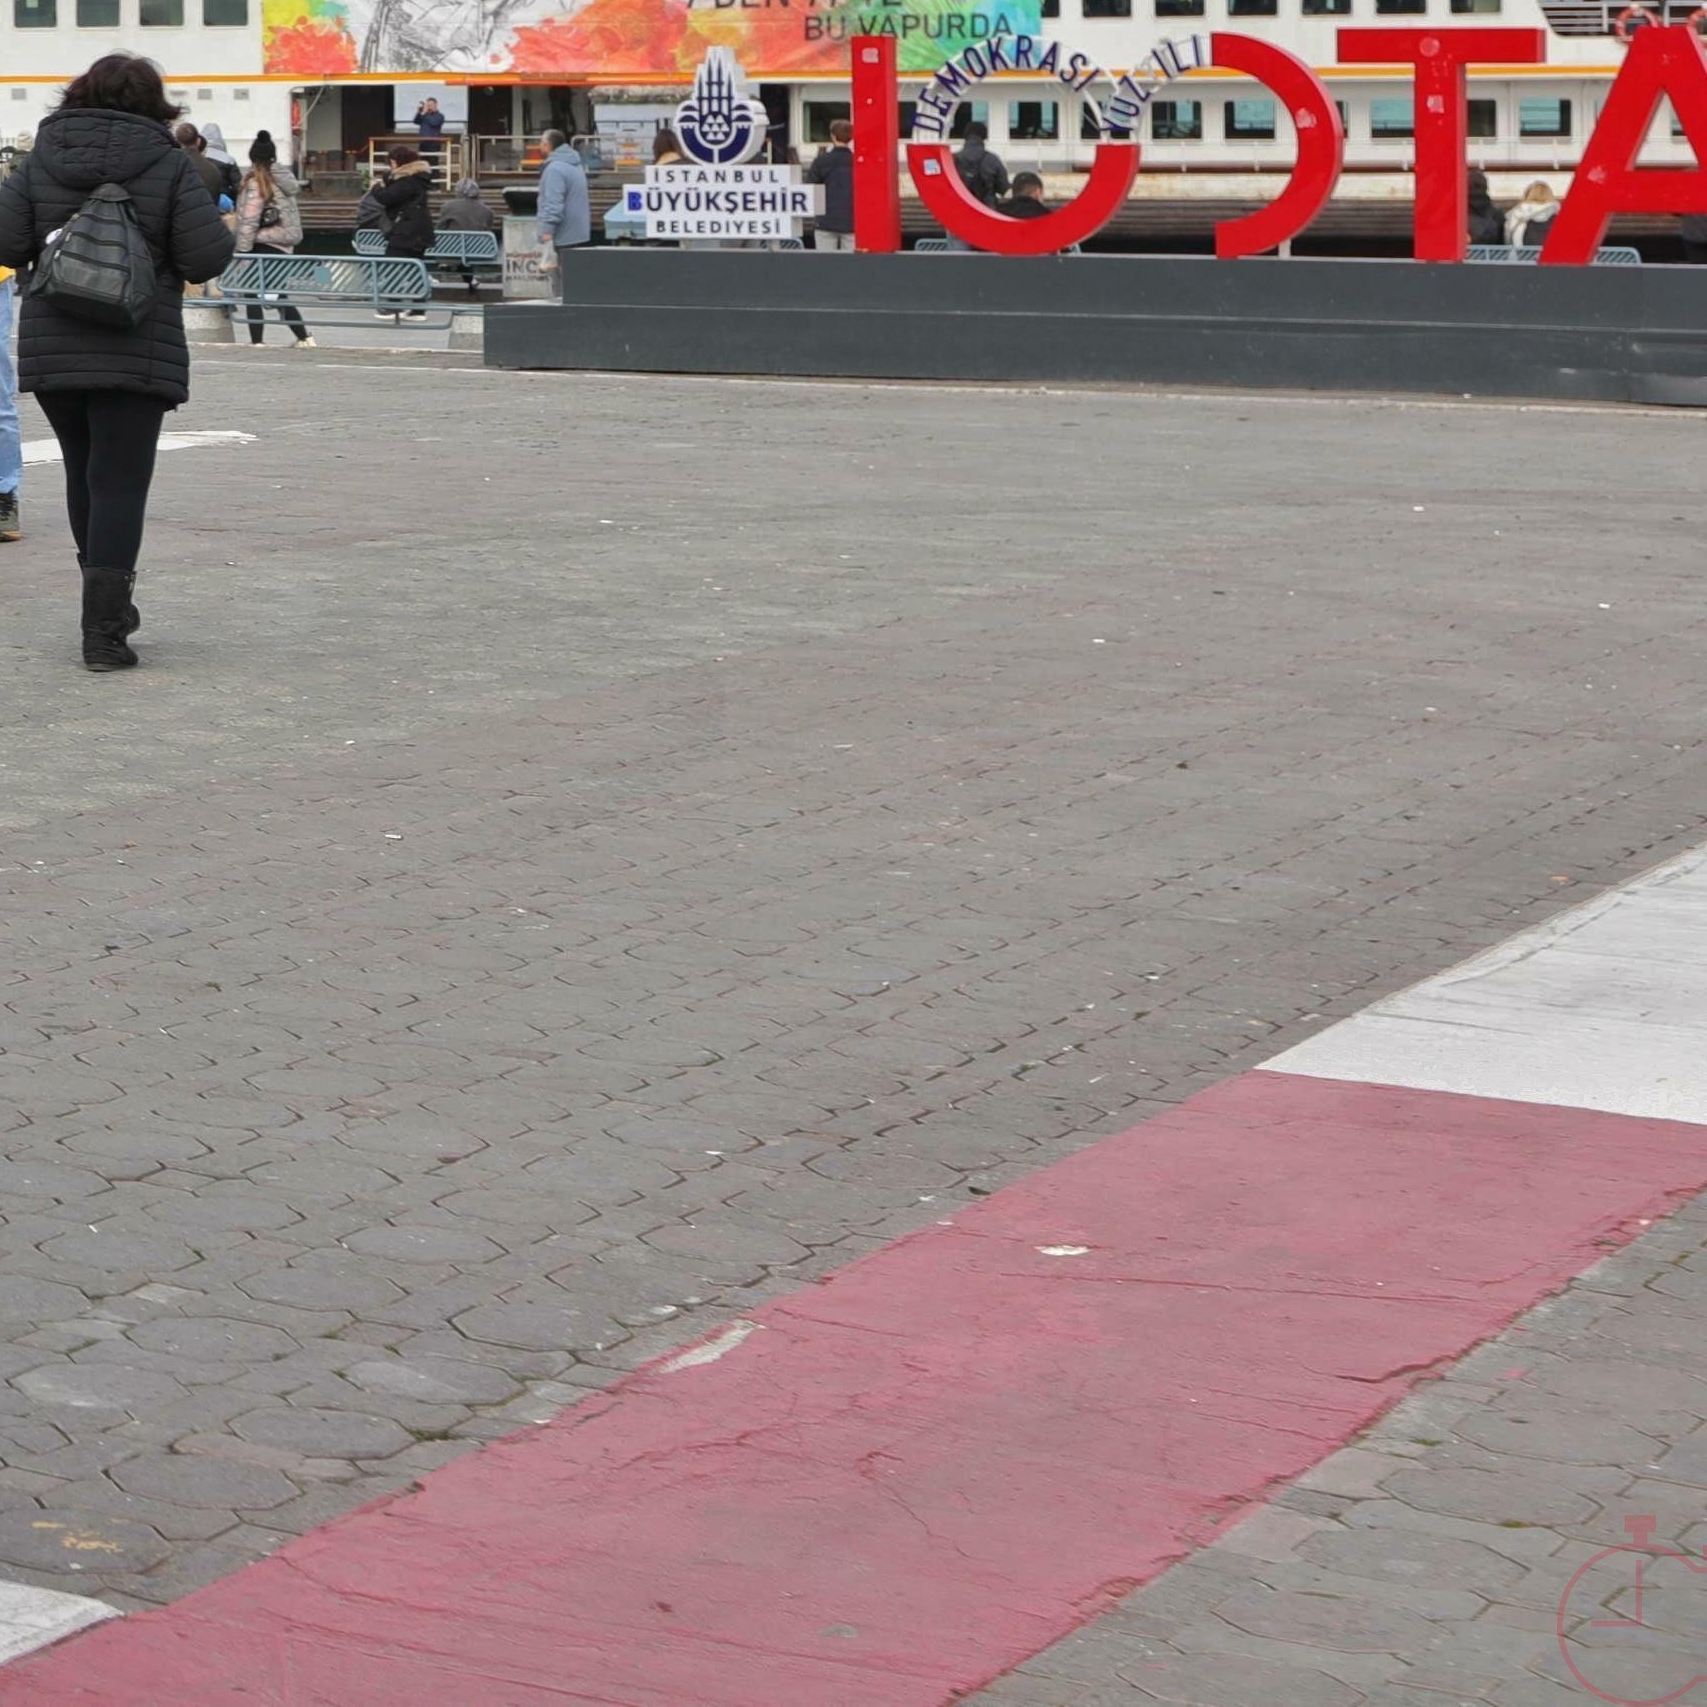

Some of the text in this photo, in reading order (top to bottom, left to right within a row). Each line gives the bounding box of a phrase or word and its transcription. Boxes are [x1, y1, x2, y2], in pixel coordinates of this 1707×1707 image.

[804, 12, 1013, 42] BU VAPURDA
[654, 169, 780, 183] İSTANBUL
[627, 187, 809, 214] BÜYÜKŞEHİR
